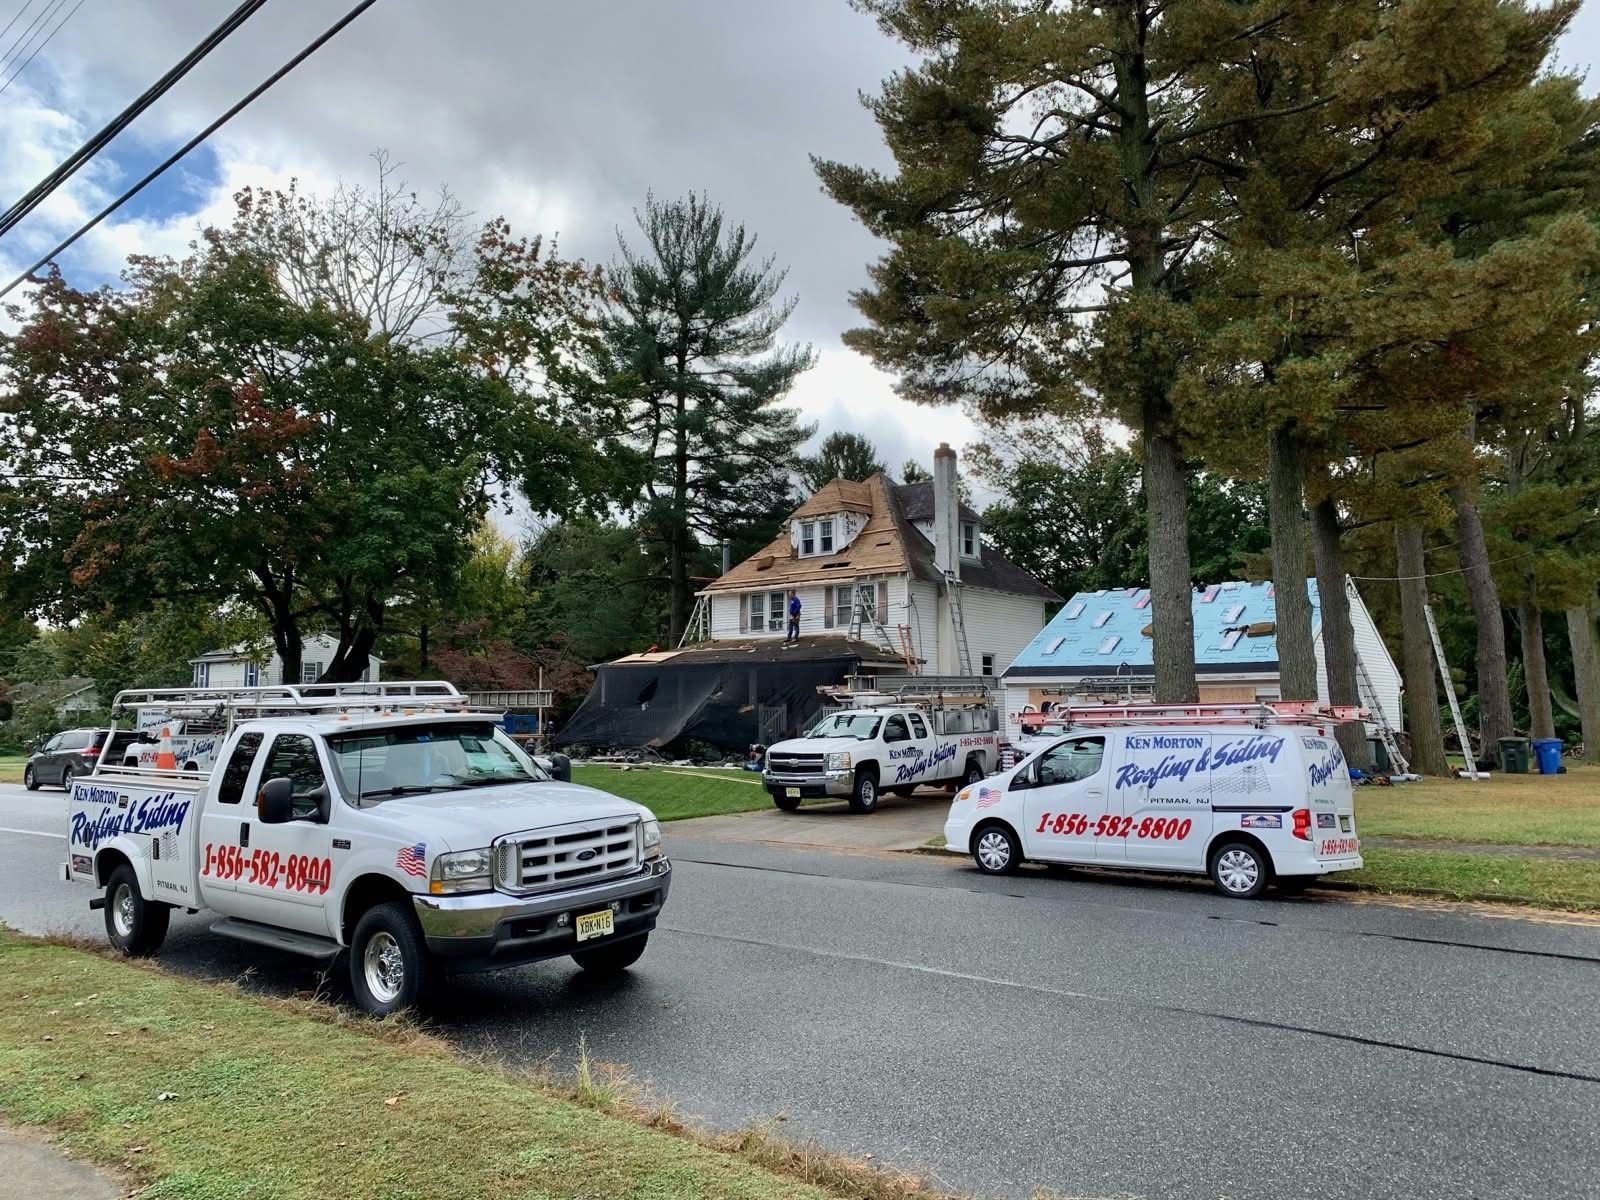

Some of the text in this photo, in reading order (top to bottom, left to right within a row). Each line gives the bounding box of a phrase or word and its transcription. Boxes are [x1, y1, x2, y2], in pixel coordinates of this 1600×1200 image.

[889, 747, 924, 760] KEN MORTON
[1125, 736, 1204, 749] KEN MORTON
[895, 741, 957, 783] Roofing & Siding
[1115, 735, 1285, 790] Roofing & Siding
[73, 785, 119, 804] KEN MORTON
[1150, 797, 1191, 805] PITMAN,
[71, 792, 191, 851] Roofing & Siding
[1036, 812, 1192, 841] 1-856-582-8800
[202, 843, 332, 895] 1-856-582-8800
[157, 879, 188, 894] PITMAN, NJ
